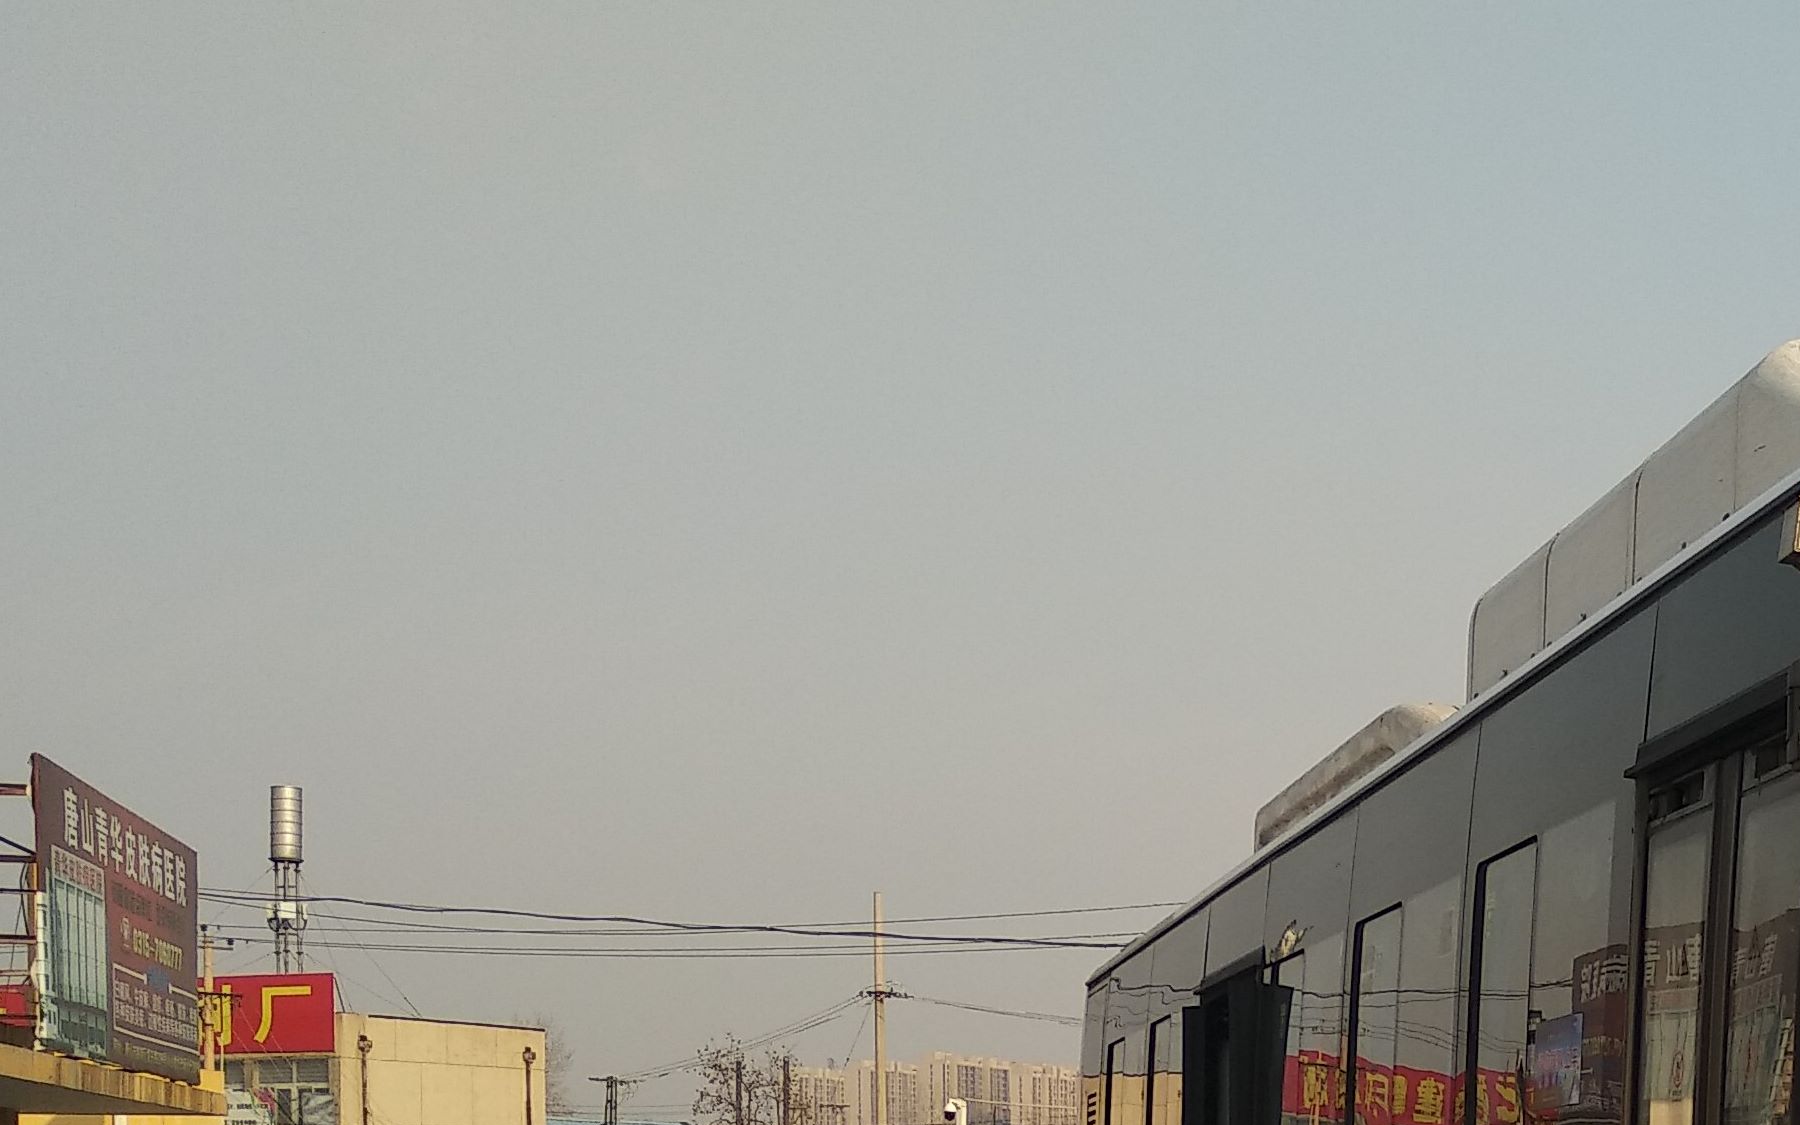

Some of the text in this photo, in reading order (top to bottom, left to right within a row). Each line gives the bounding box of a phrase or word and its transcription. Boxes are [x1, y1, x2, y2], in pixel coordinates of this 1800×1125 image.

[62, 786, 188, 907] 唐山青华皮肤病医院
